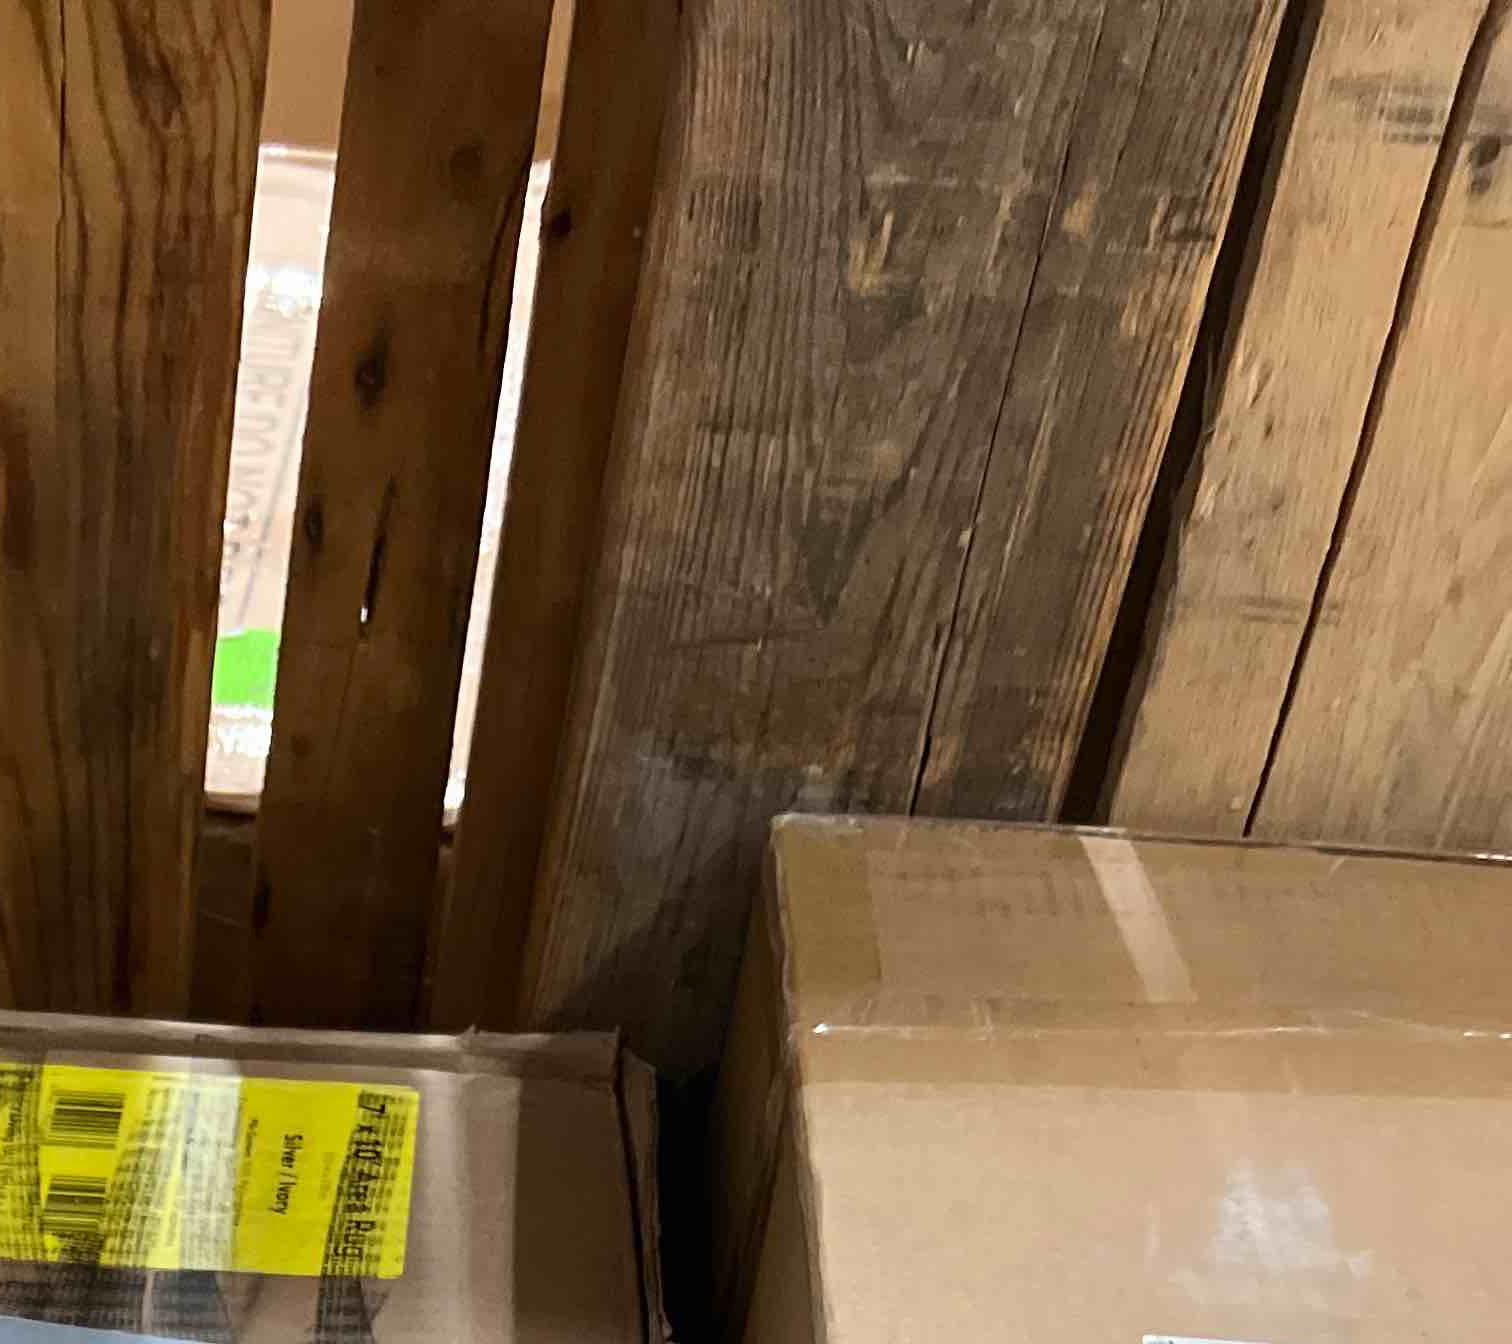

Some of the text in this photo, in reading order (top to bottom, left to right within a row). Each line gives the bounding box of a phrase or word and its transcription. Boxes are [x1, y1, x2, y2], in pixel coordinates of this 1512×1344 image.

[280, 1133, 304, 1169] Silver
[269, 1181, 296, 1216] Ivory
[345, 1170, 379, 1213] Area
[332, 1219, 377, 1260] Rug
